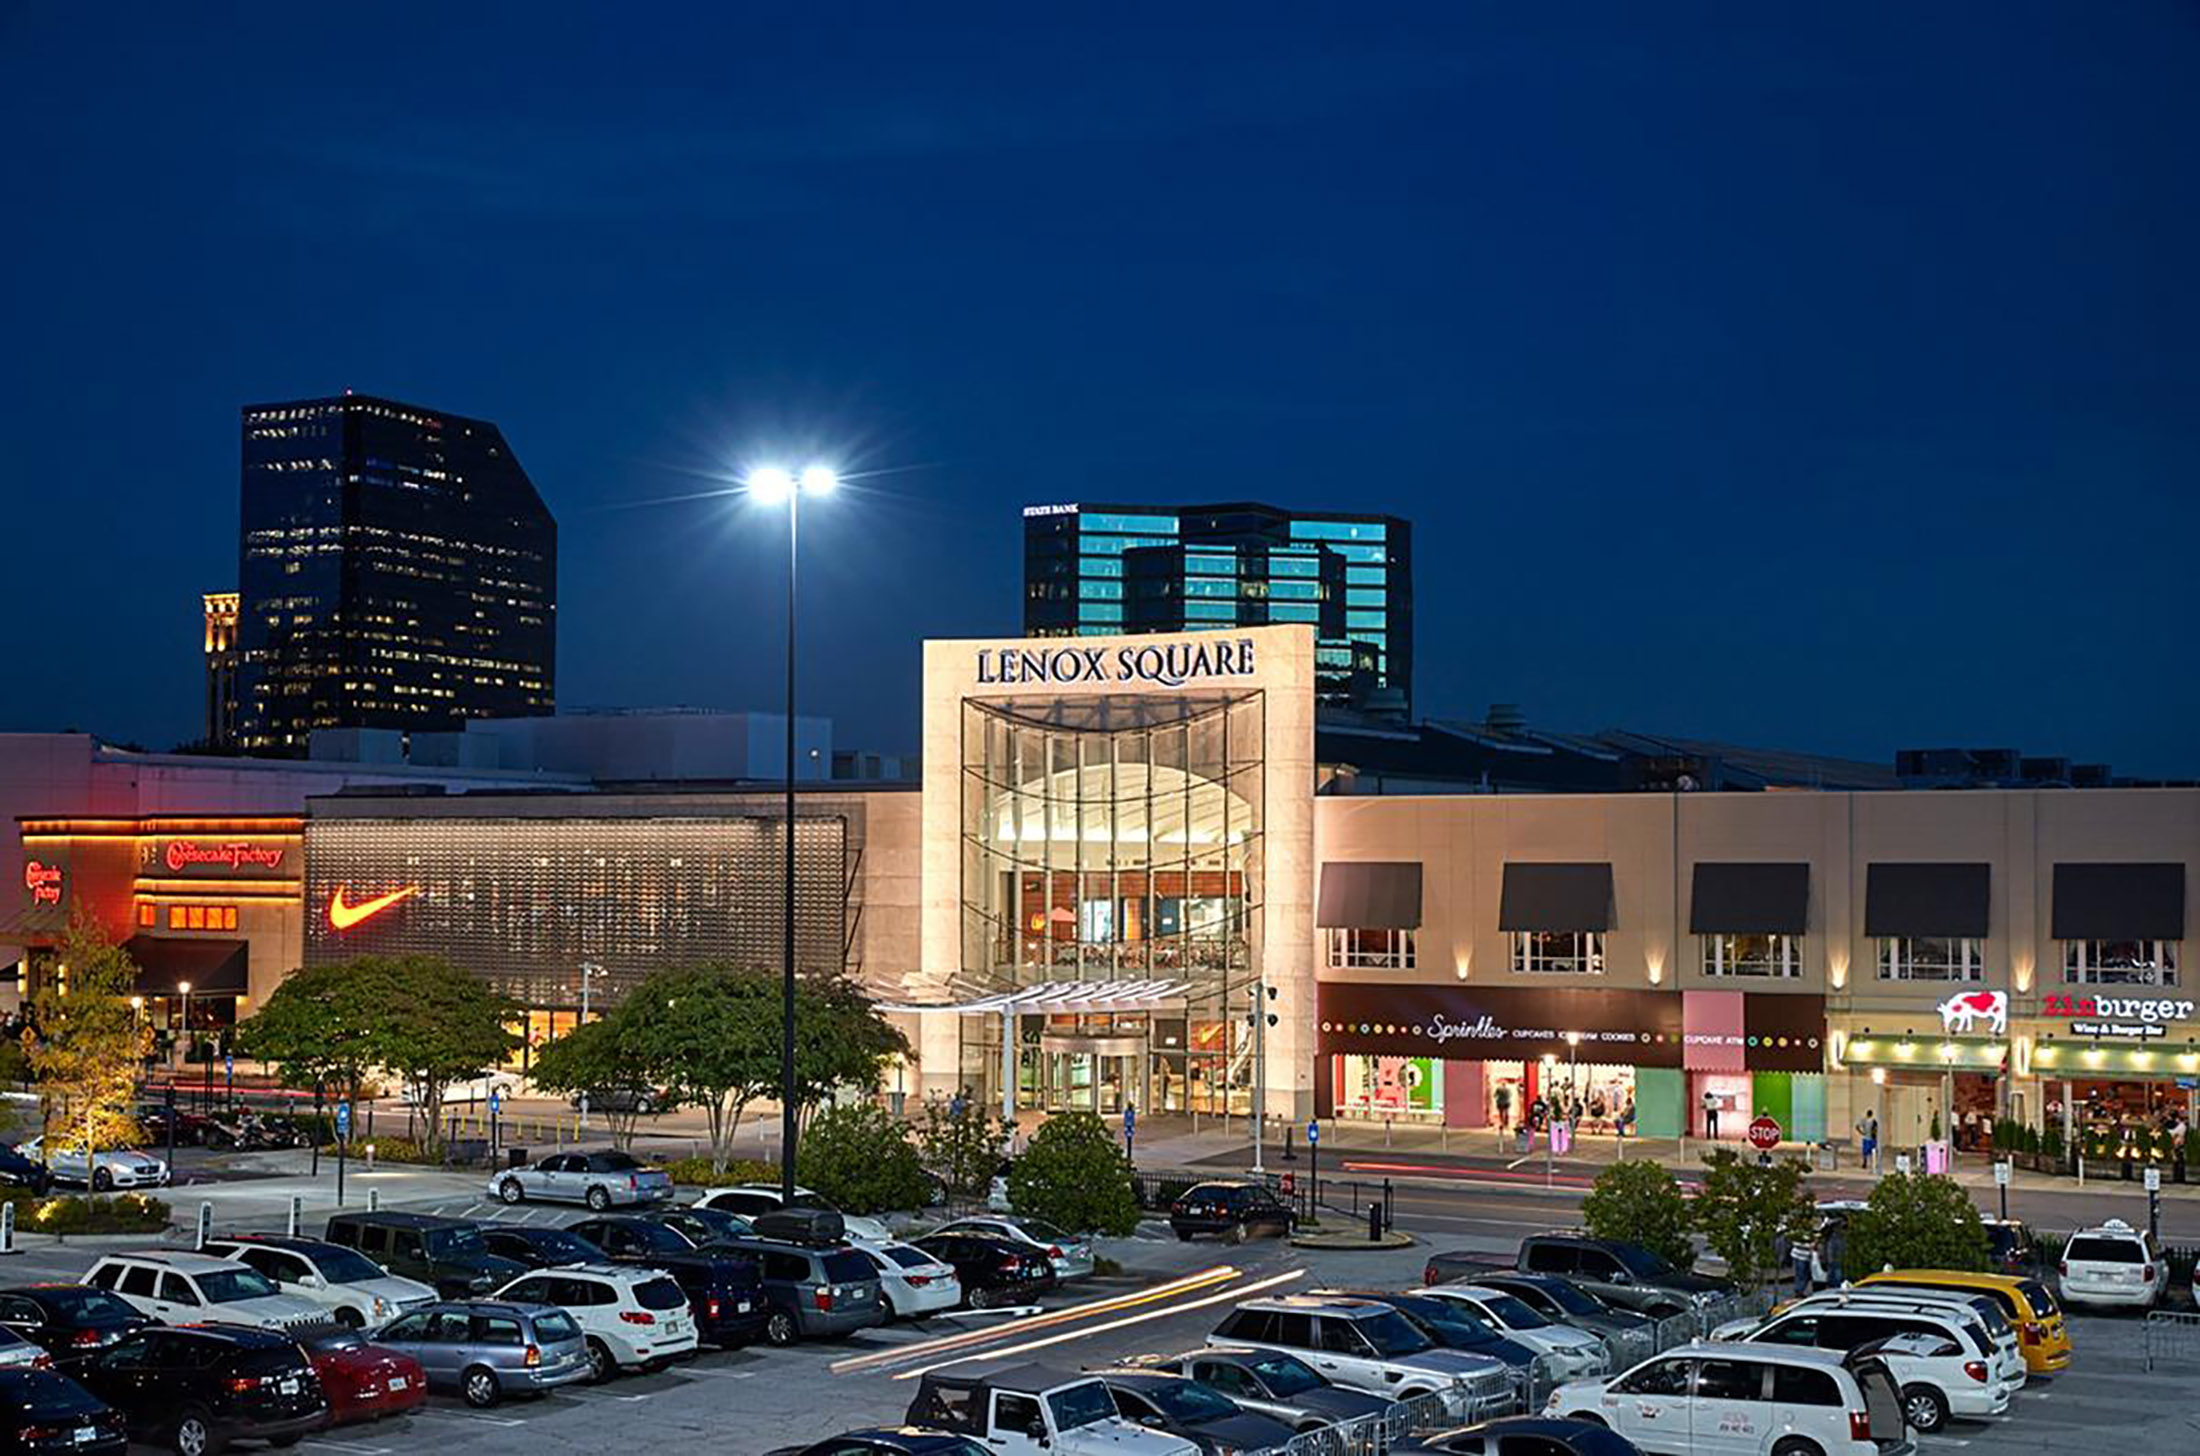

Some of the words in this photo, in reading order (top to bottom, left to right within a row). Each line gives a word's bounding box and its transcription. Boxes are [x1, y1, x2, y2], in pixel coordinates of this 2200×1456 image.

[1023, 505, 1051, 517] STATE
[1052, 503, 1079, 514] BANK
[977, 649, 1108, 683] LENOX
[1117, 639, 1254, 686] SQUARE
[226, 843, 282, 869] Factory
[1427, 1014, 1508, 1044] Sprinkles
[1512, 1029, 1555, 1039] CUPCAKES
[1601, 1032, 1636, 1042] COOKIES
[1750, 1125, 1779, 1141] STOP
